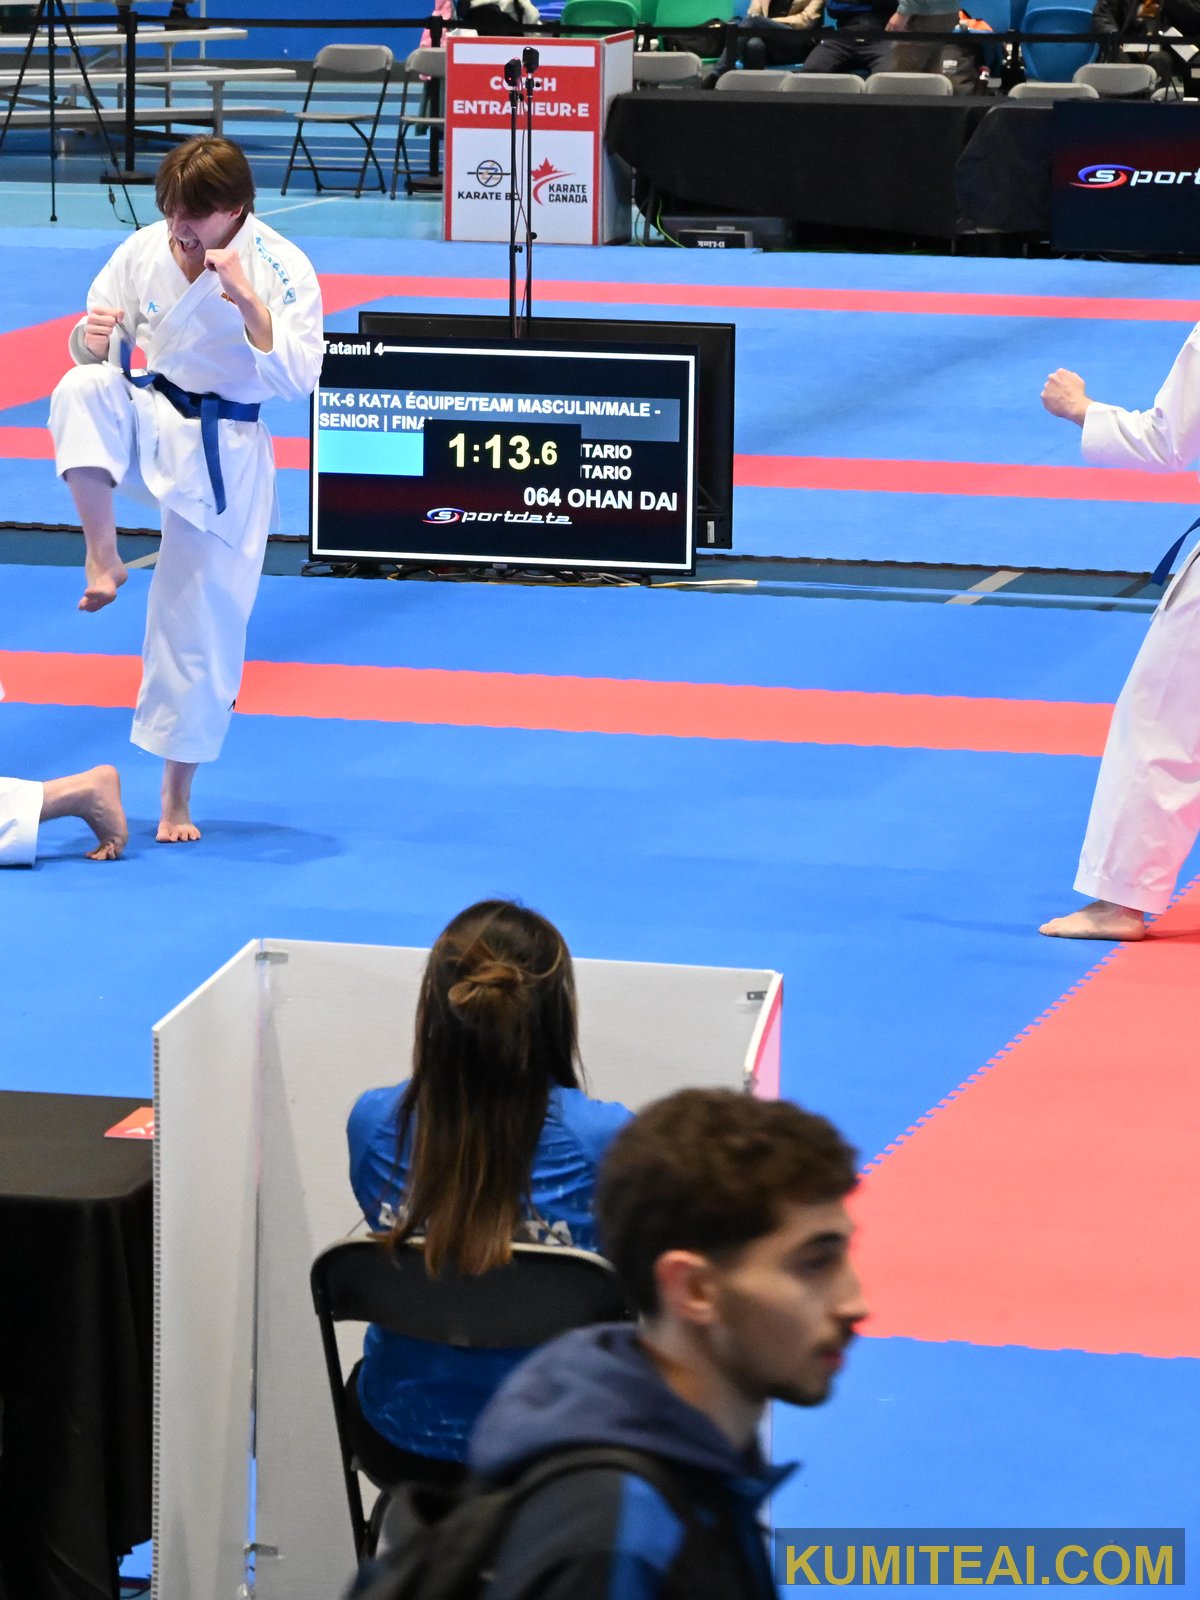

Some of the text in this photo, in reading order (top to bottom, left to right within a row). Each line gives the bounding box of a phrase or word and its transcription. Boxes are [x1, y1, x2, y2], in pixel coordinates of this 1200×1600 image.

[490, 76, 557, 92] CCH
[549, 183, 587, 193] KARATE
[457, 191, 501, 201] KARATE
[549, 193, 588, 203] CANADA
[697, 240, 725, 248] D-Link
[323, 341, 385, 356] Tatami 4
[319, 392, 355, 408] TK-6
[358, 393, 402, 409] KATA
[405, 391, 513, 413] ÉQUIPE/TEAM
[517, 399, 651, 418] MASCULIN/MALE
[319, 413, 380, 429] SENIOR
[392, 415, 433, 430] FINA
[449, 433, 558, 471] 1:13.6
[580, 444, 632, 459] TARIO
[580, 465, 632, 480] TARIO
[523, 487, 678, 511] 064 OHAN DAI
